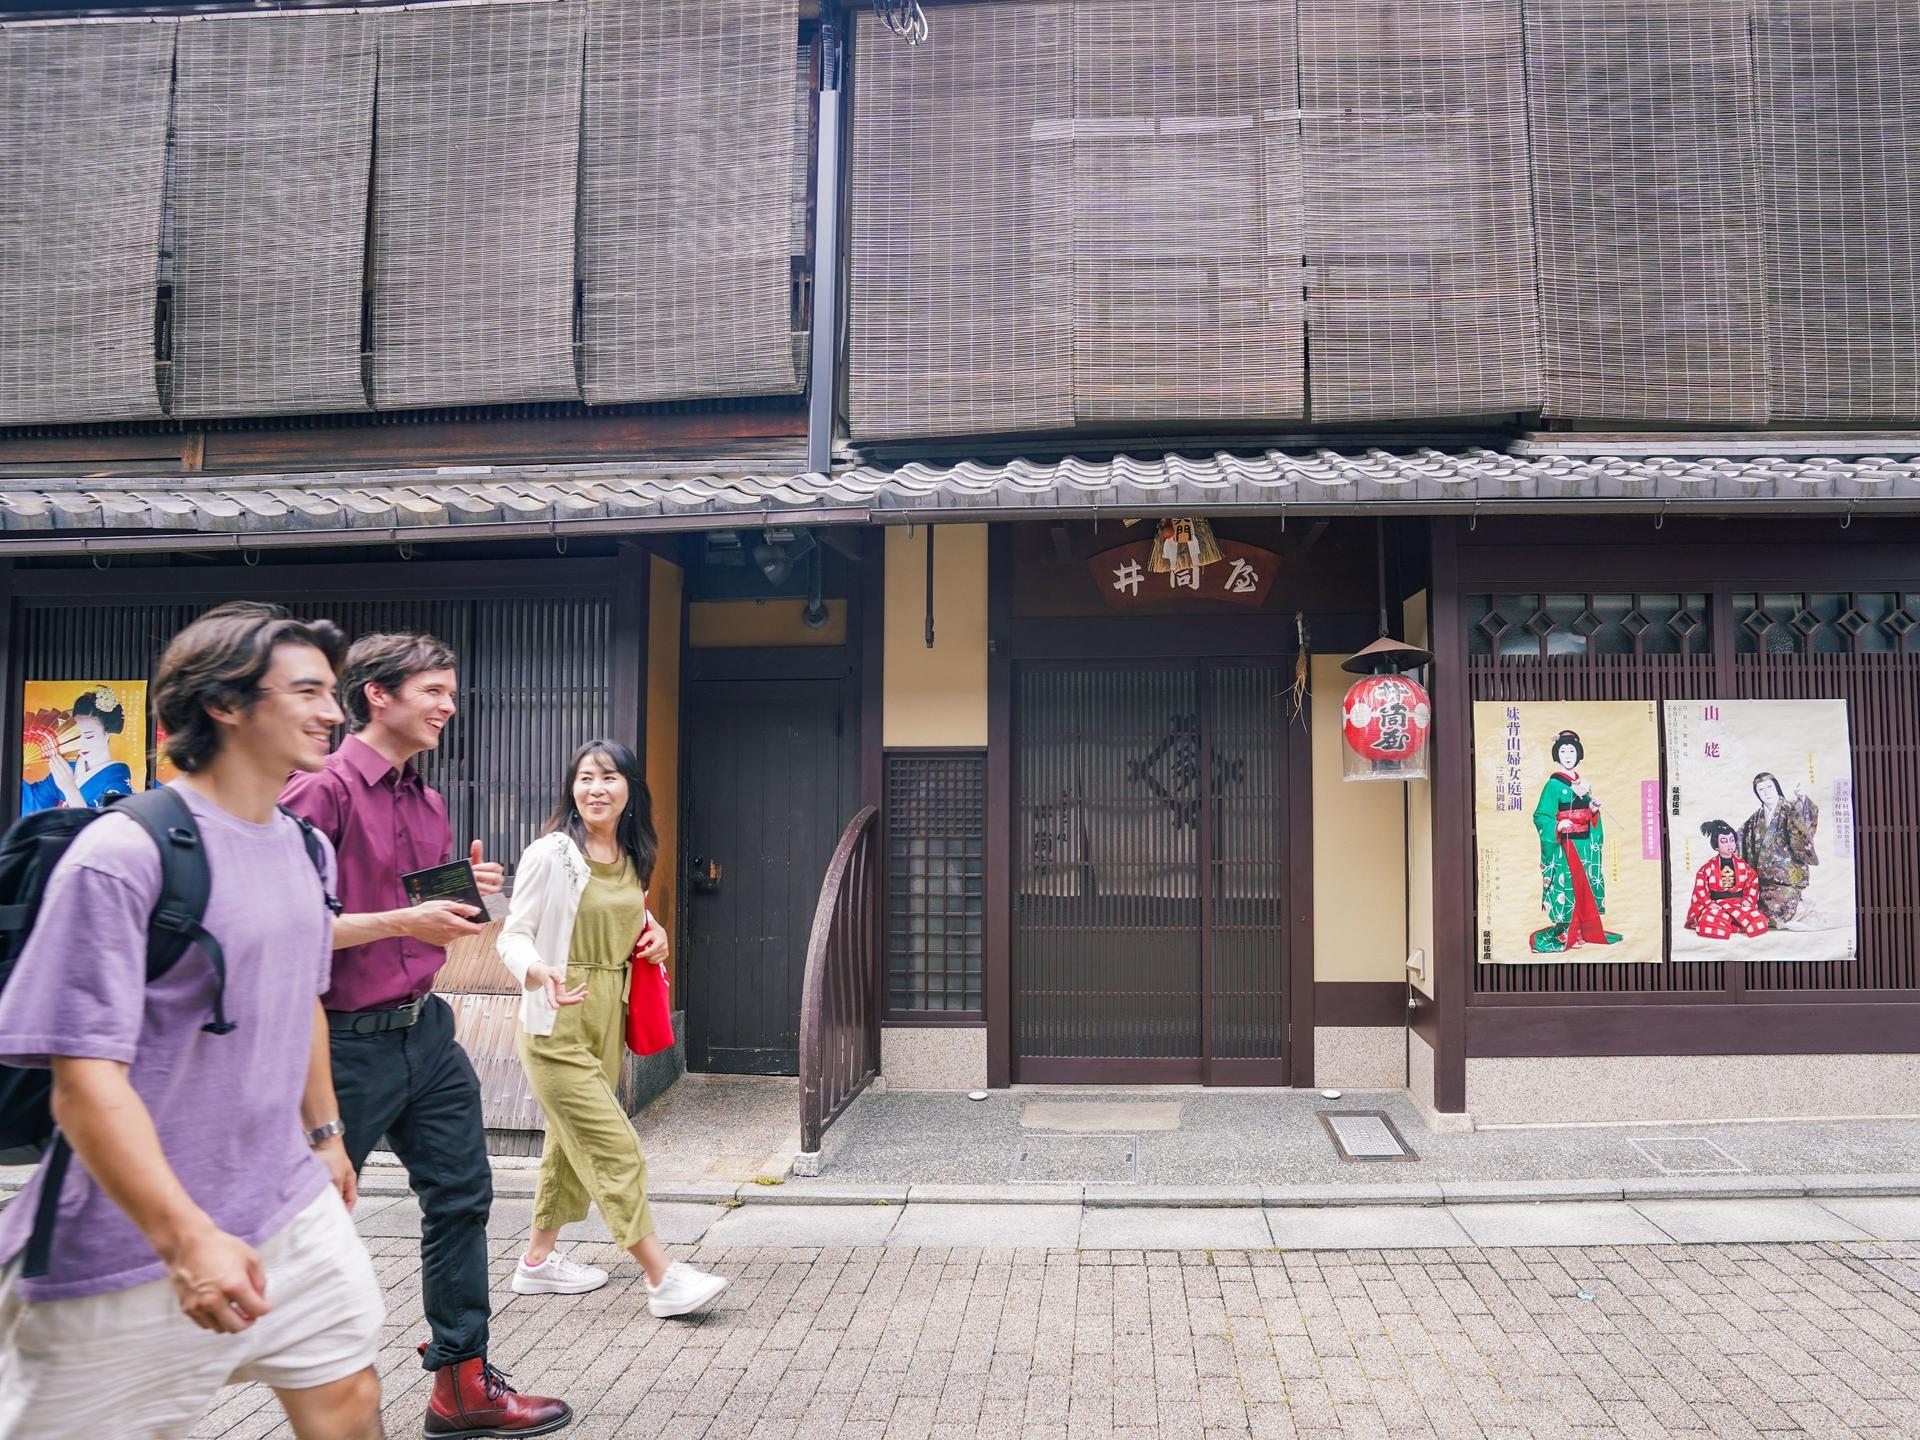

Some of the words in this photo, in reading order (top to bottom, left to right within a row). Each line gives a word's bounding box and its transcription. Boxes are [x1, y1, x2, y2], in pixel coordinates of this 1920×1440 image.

[1506, 706, 1522, 811] 妹背山婦女庭訓
[1704, 705, 1720, 758] 山姥
